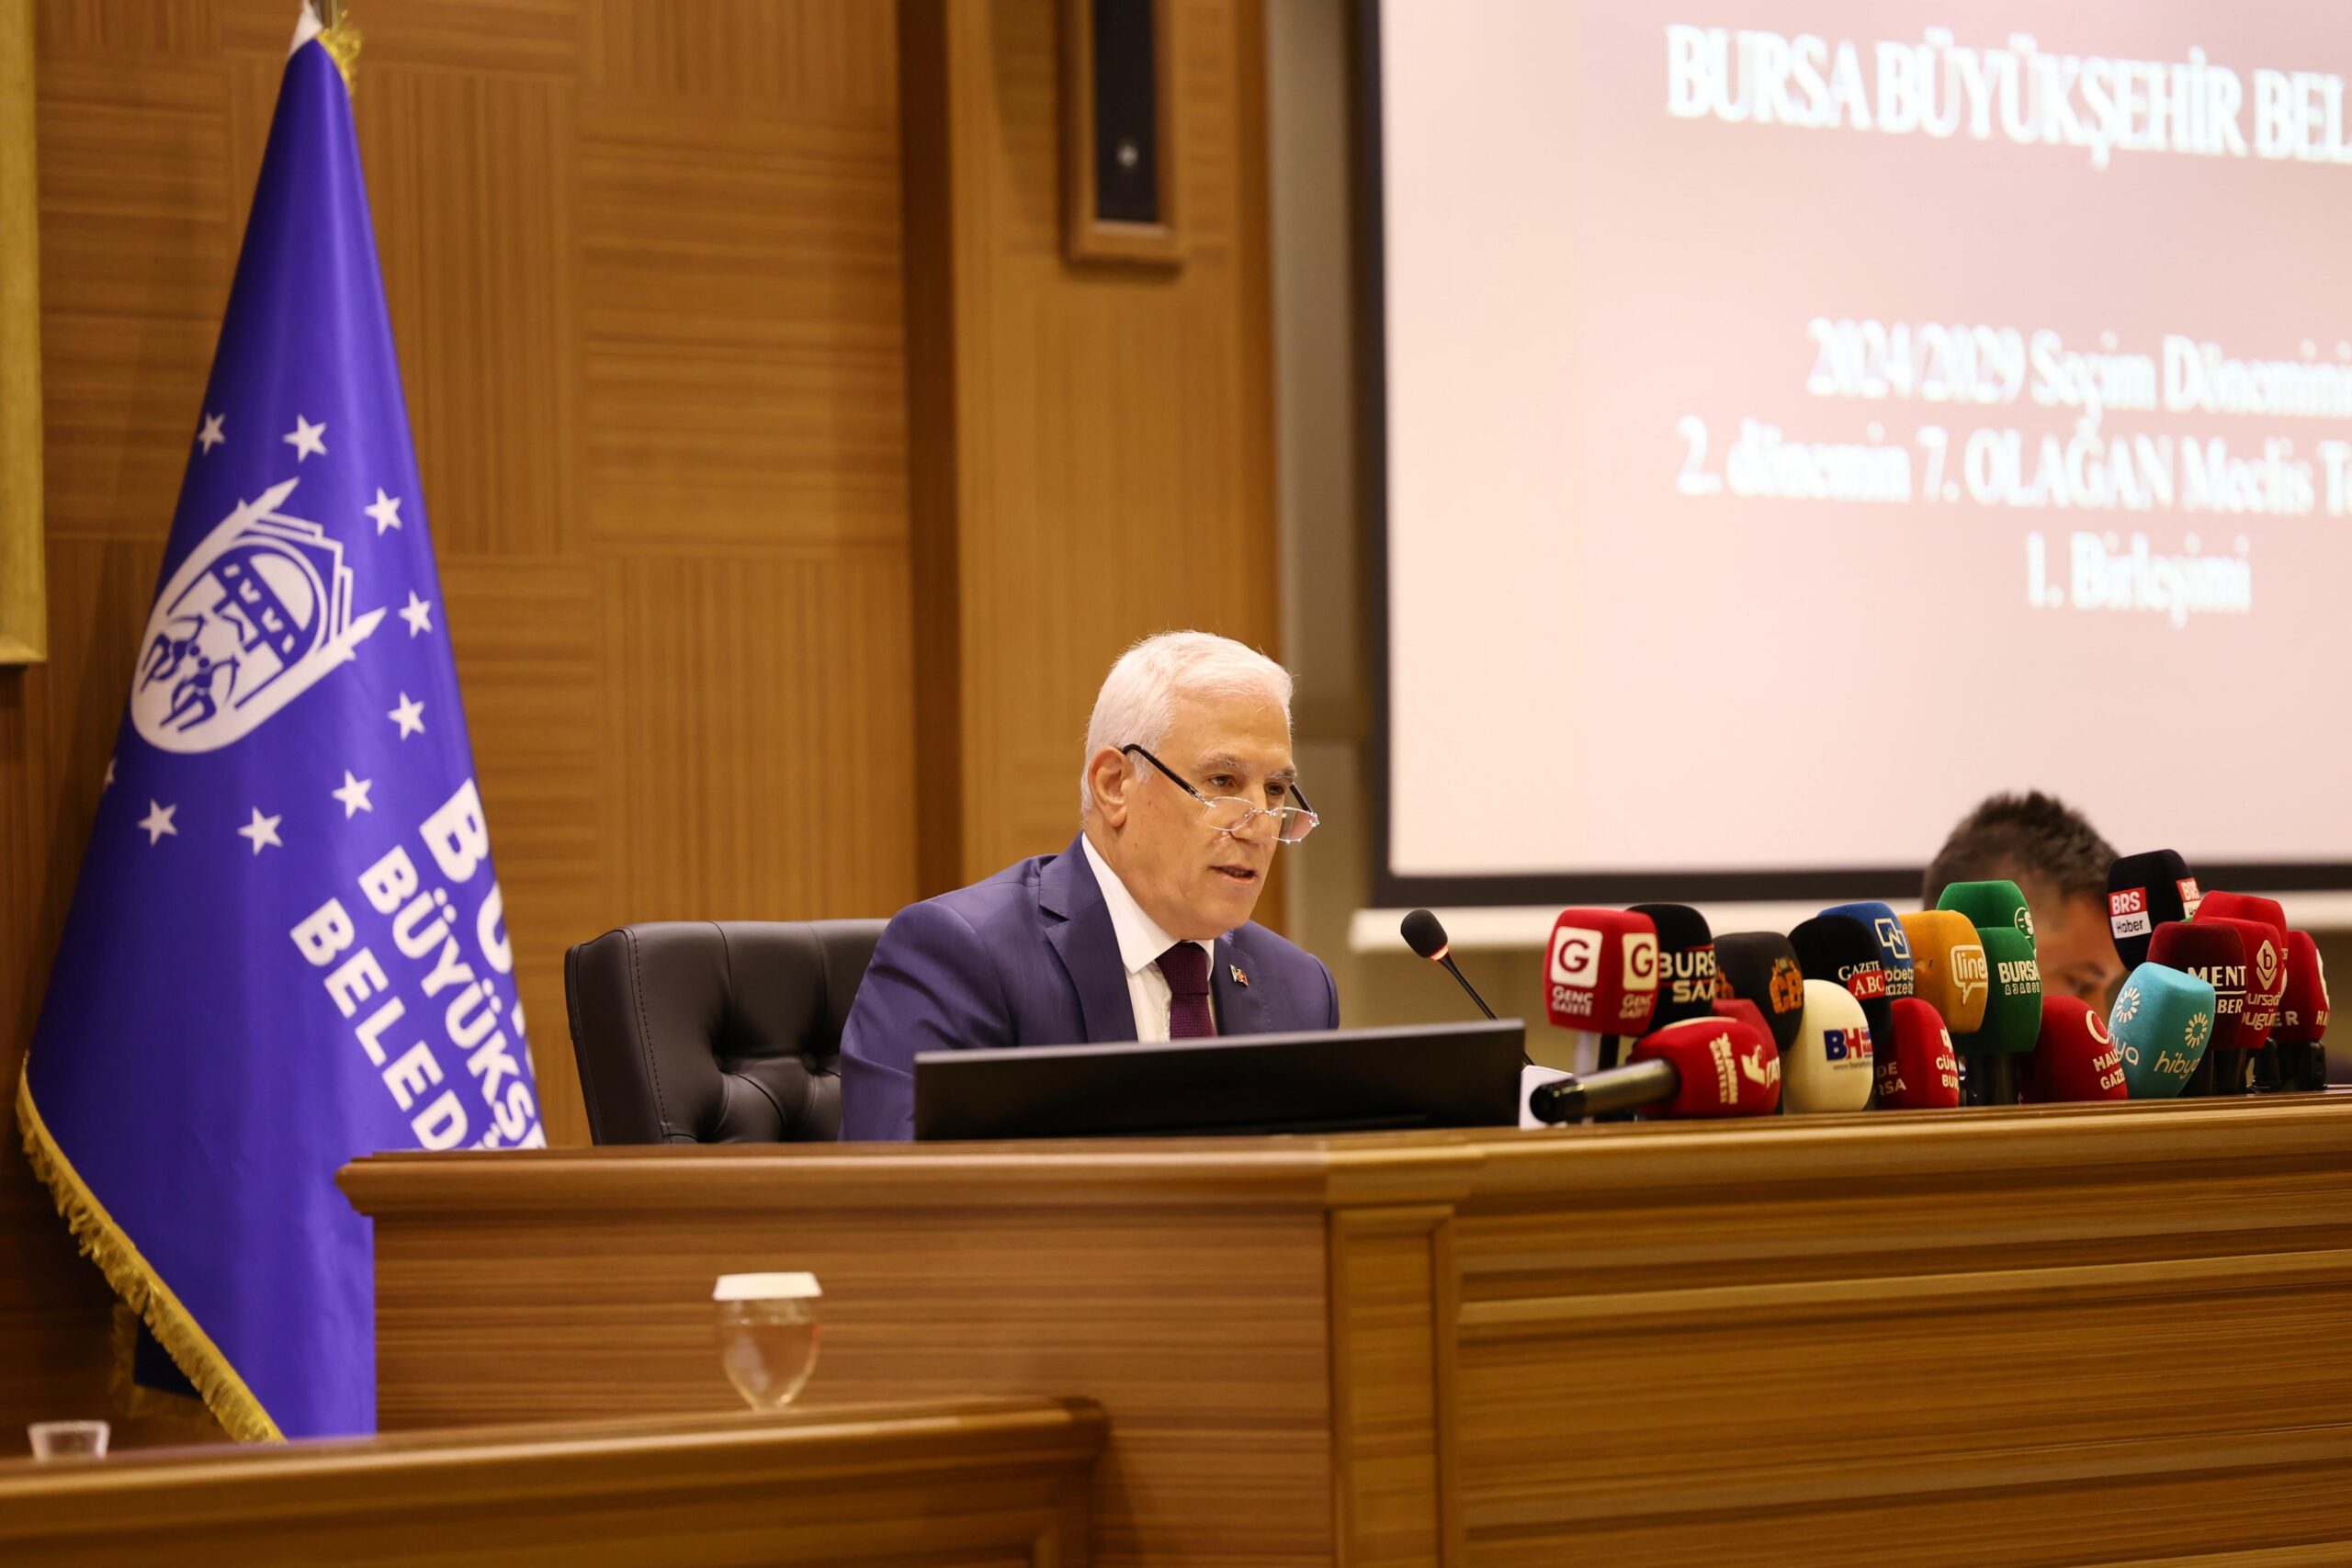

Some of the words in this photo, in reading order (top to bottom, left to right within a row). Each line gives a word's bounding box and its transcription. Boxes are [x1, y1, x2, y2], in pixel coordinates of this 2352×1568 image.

[1668, 24, 1871, 130] BURSA
[1875, 26, 2246, 171] BÜYÜKŞEHİR
[2030, 328, 2156, 430] Seçim
[1676, 414, 1722, 495] 2.
[1917, 426, 1960, 503] 7.
[1964, 420, 2174, 511] OLAĞAN
[2181, 434, 2314, 514] Meclis
[2111, 891, 2141, 915] BRS
[2116, 919, 2143, 934] Haber
[1559, 939, 1589, 973] G
[1631, 943, 1654, 977] G
[1838, 960, 1882, 982] GAZETE
[1854, 974, 1885, 997] ABC
[1998, 960, 2040, 984] BURSA
